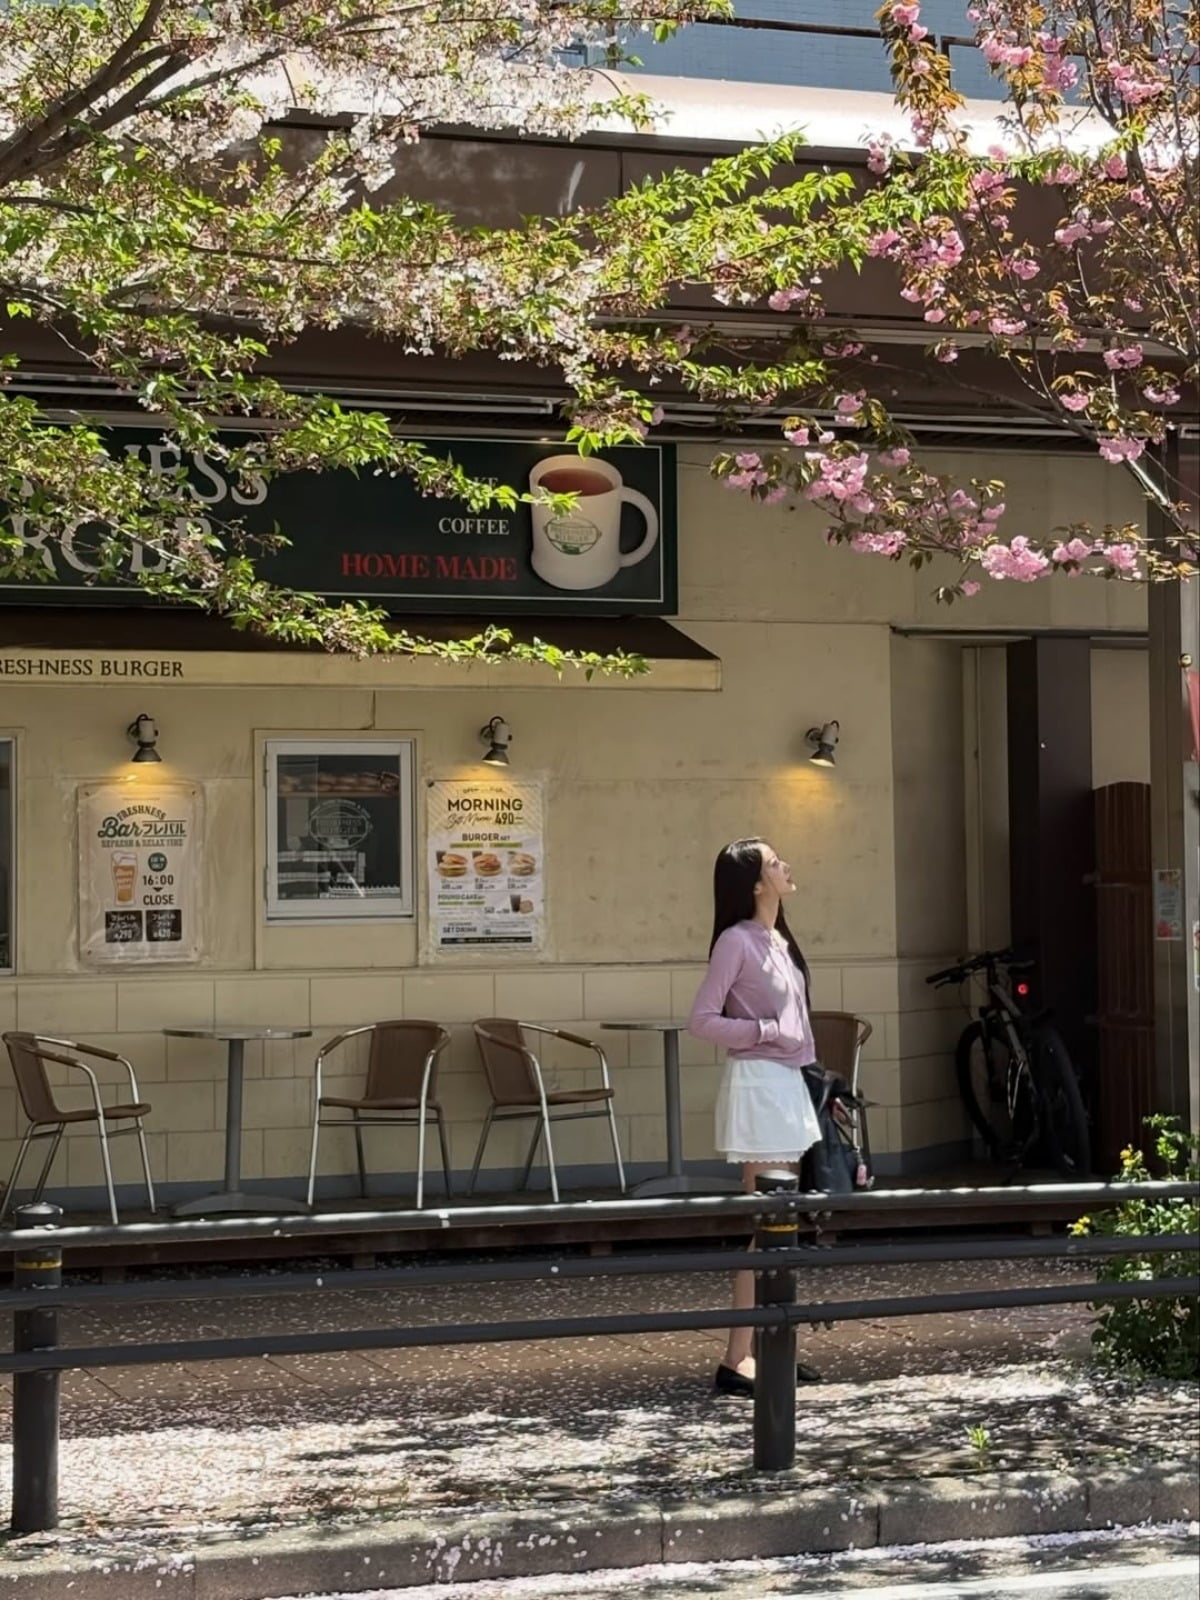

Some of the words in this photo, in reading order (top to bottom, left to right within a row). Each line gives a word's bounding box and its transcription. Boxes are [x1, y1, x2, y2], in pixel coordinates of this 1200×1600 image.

[438, 517, 510, 535] COFFEE
[340, 552, 430, 579] HOME
[435, 555, 518, 582] MADE
[0, 658, 93, 676] ESHNESS
[100, 659, 184, 678] BURGER
[447, 798, 523, 811] MORNING
[117, 805, 167, 821] FRESHNESS
[495, 812, 514, 825] 490
[98, 816, 144, 839] Bar
[143, 823, 187, 835] フレバル
[461, 833, 500, 841] BURGER
[142, 874, 174, 886] 16:00
[142, 894, 174, 906] CLOSE
